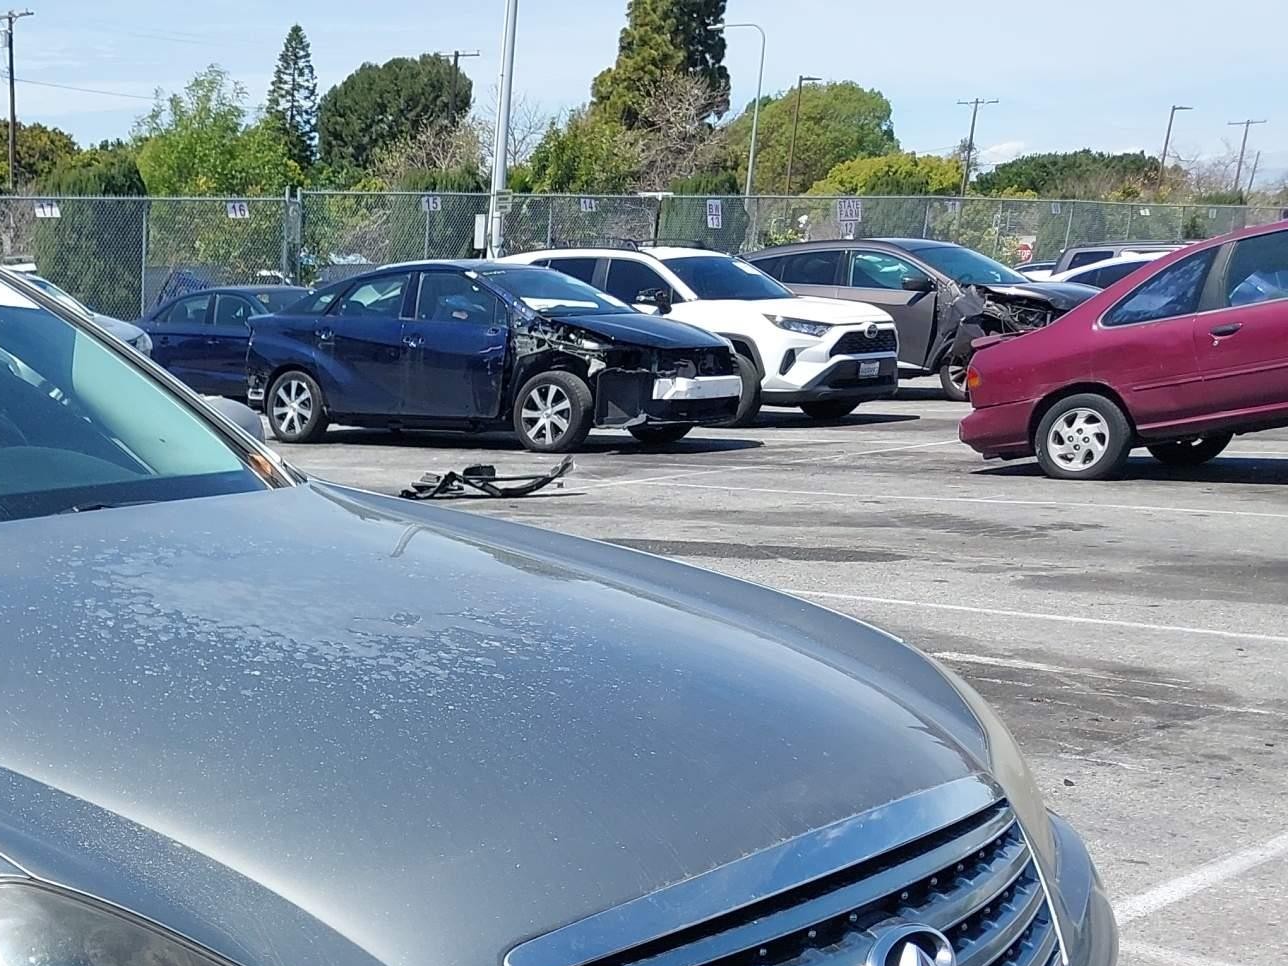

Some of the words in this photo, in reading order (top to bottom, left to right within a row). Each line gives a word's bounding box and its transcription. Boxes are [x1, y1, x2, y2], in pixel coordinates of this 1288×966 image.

[425, 197, 438, 210] 15
[583, 199, 594, 210] 14
[838, 200, 860, 209] STATE
[39, 203, 54, 217] 17
[232, 203, 246, 217] 16
[710, 216, 720, 227] 13
[844, 222, 853, 233] 12
